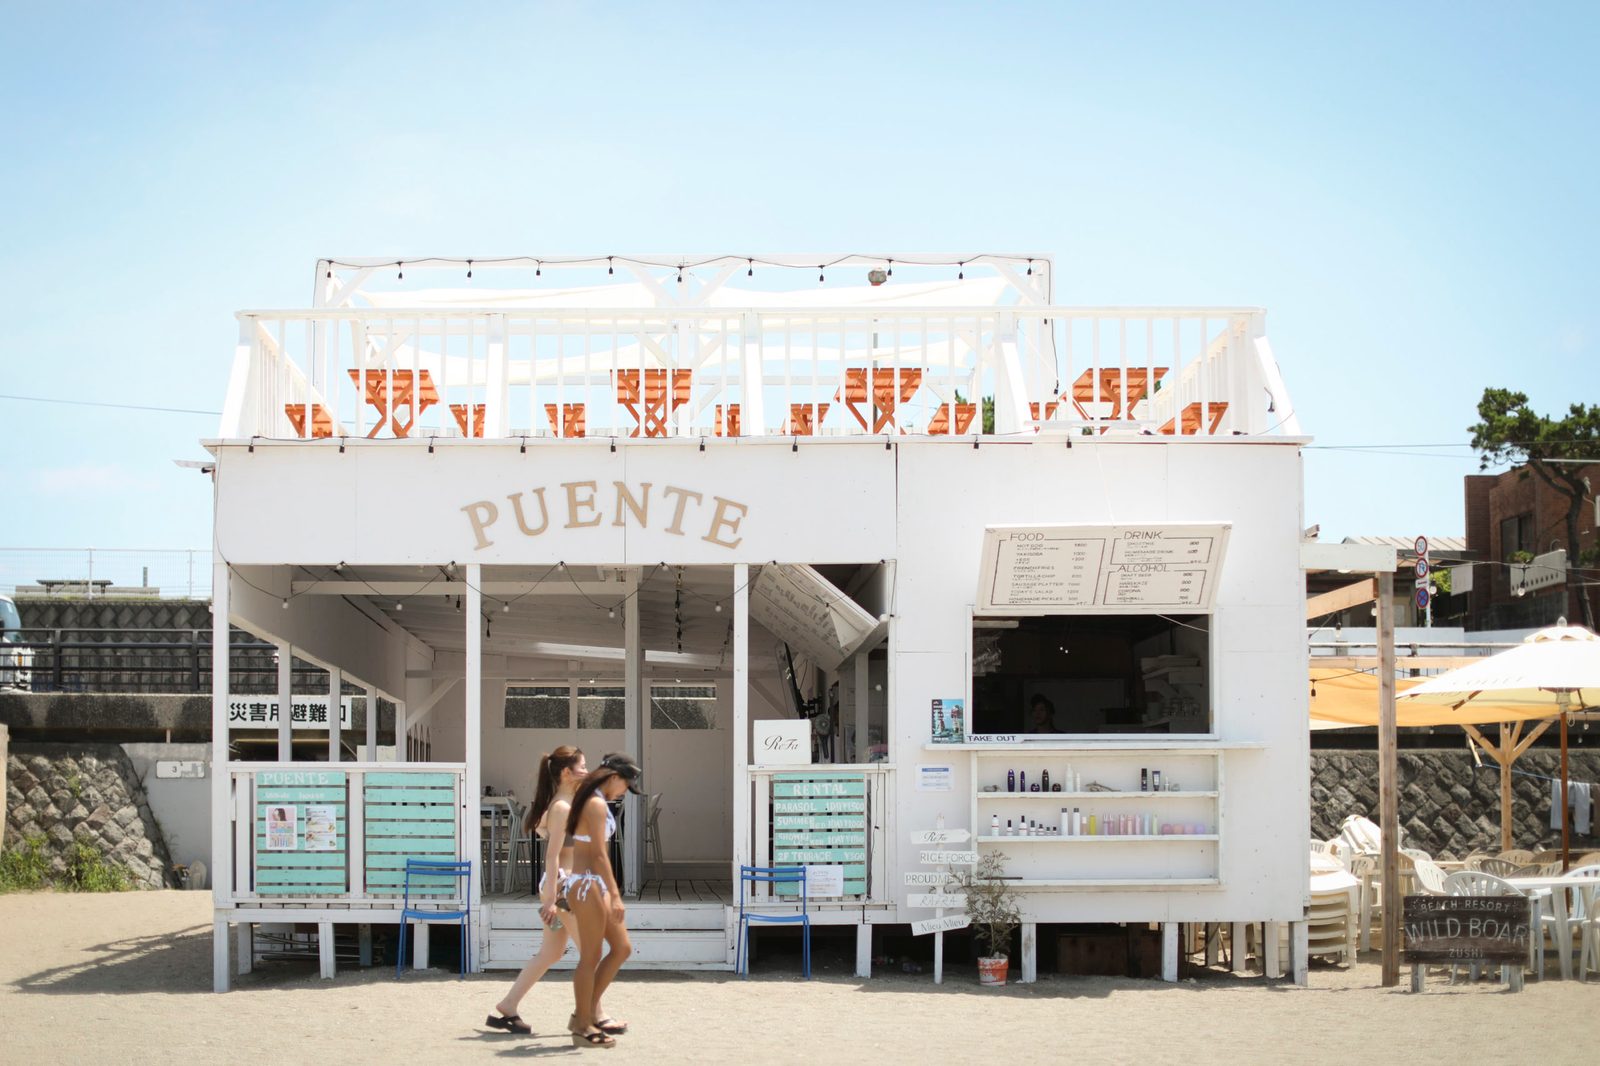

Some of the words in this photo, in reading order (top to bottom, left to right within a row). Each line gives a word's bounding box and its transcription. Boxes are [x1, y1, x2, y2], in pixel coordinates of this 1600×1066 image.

[460, 480, 748, 550] PUENTE
[1010, 532, 1044, 541] FOOD
[1124, 531, 1163, 540] DRINK
[1117, 564, 1171, 572] ALCOHOL
[263, 772, 329, 785] PUENTE
[793, 784, 847, 796] RENTAL
[776, 802, 816, 812] PARASOL
[776, 816, 815, 826] SUMMER
[791, 852, 832, 860] TERRACE
[920, 852, 944, 862] RICE
[946, 852, 976, 862] FORCE
[1420, 900, 1458, 912] BEACH
[1464, 900, 1511, 912] RESORT
[1404, 918, 1461, 944] WILD
[1469, 918, 1528, 946] BOAR
[1449, 948, 1484, 958] ZUSHI
